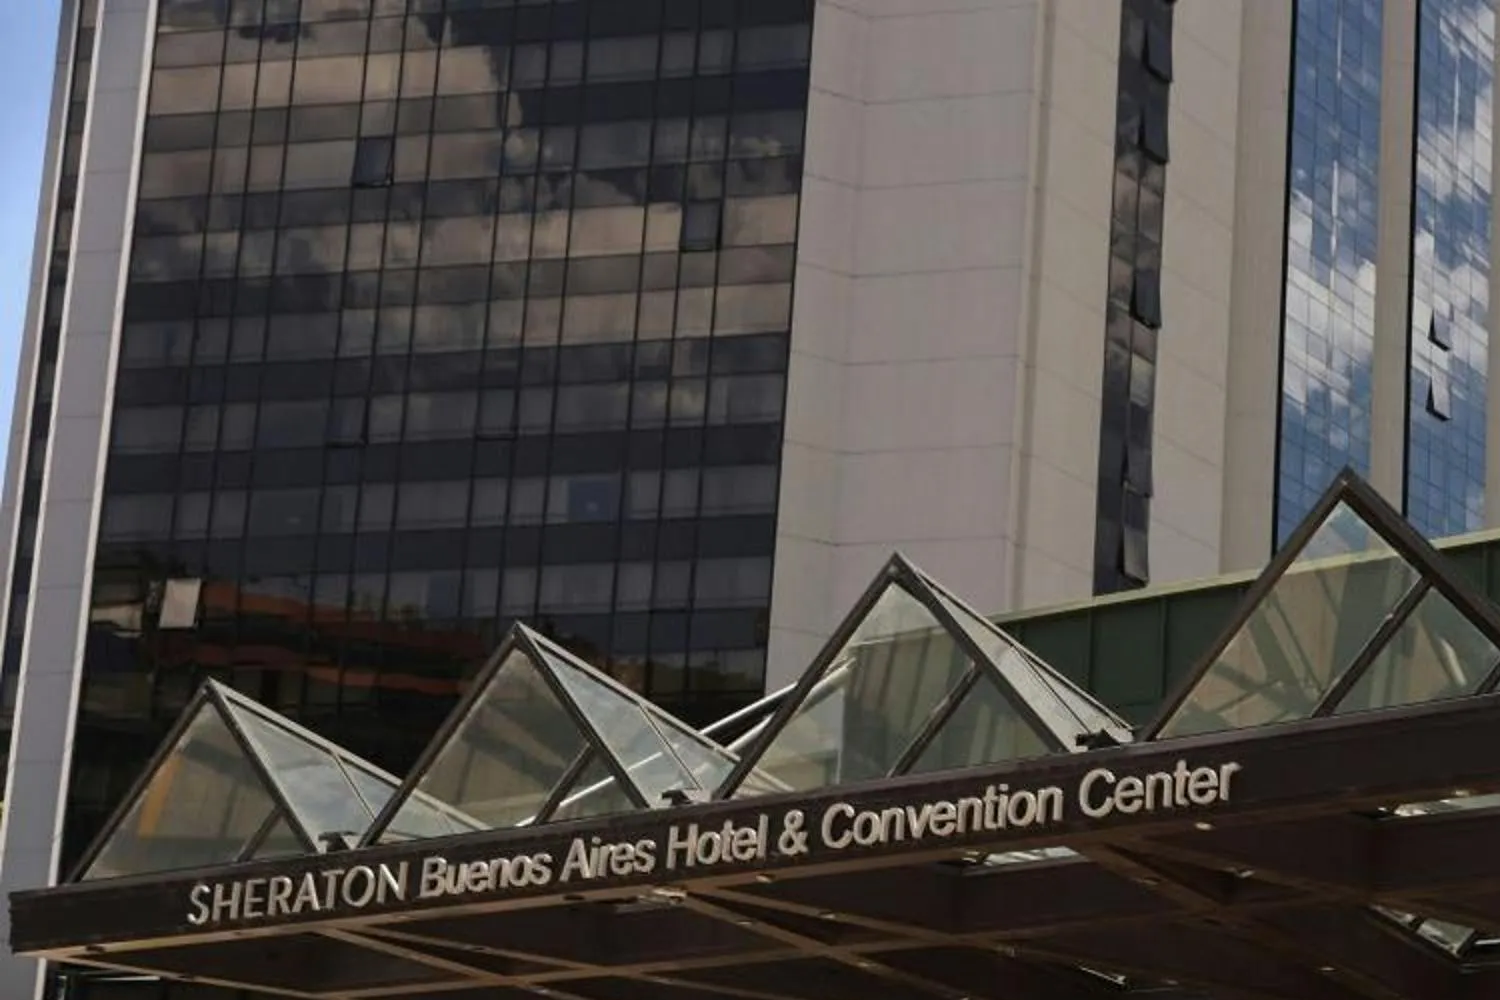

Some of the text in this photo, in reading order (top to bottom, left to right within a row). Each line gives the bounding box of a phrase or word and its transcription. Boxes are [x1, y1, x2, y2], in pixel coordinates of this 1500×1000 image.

[186, 759, 1241, 925] SHERATON Buenos Aires Hotel & Convention Center
